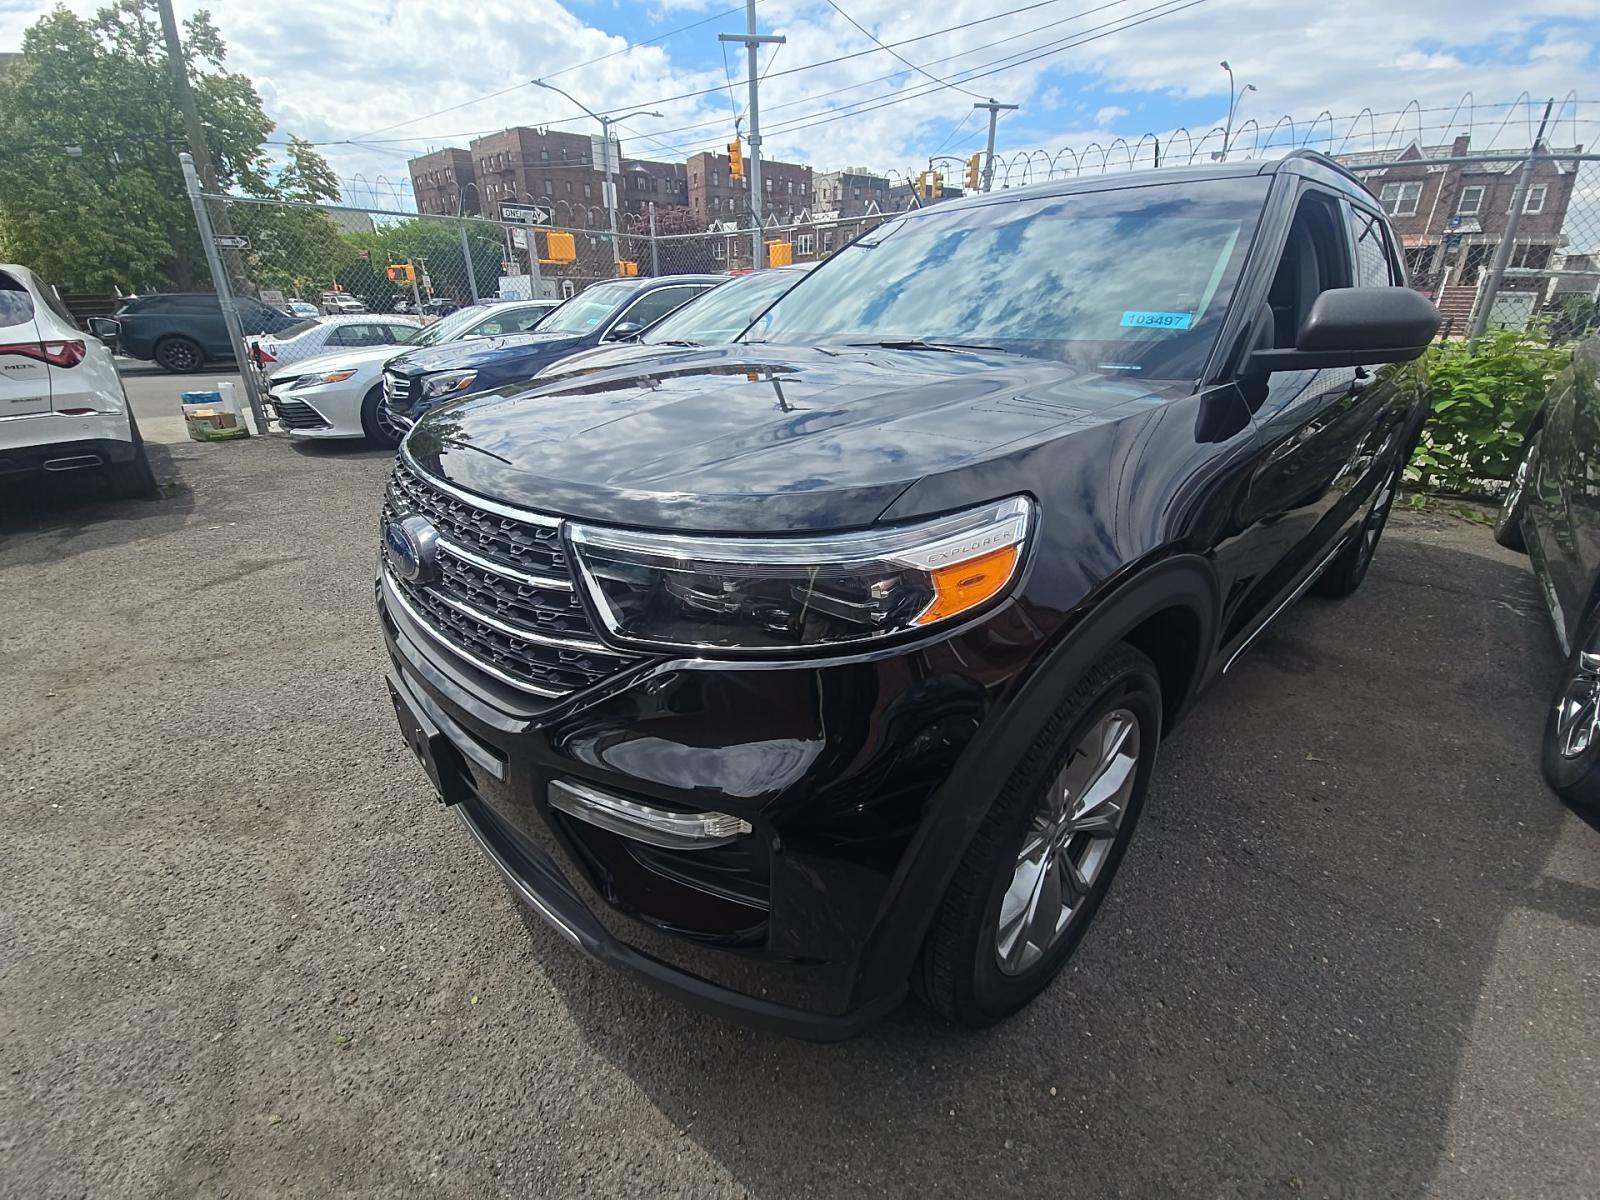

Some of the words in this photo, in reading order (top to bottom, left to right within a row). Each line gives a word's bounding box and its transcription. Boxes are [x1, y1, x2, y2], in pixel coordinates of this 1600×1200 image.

[505, 209, 521, 218] ONE
[1128, 314, 1184, 326] 103497
[928, 530, 1010, 562] EXPLORER
